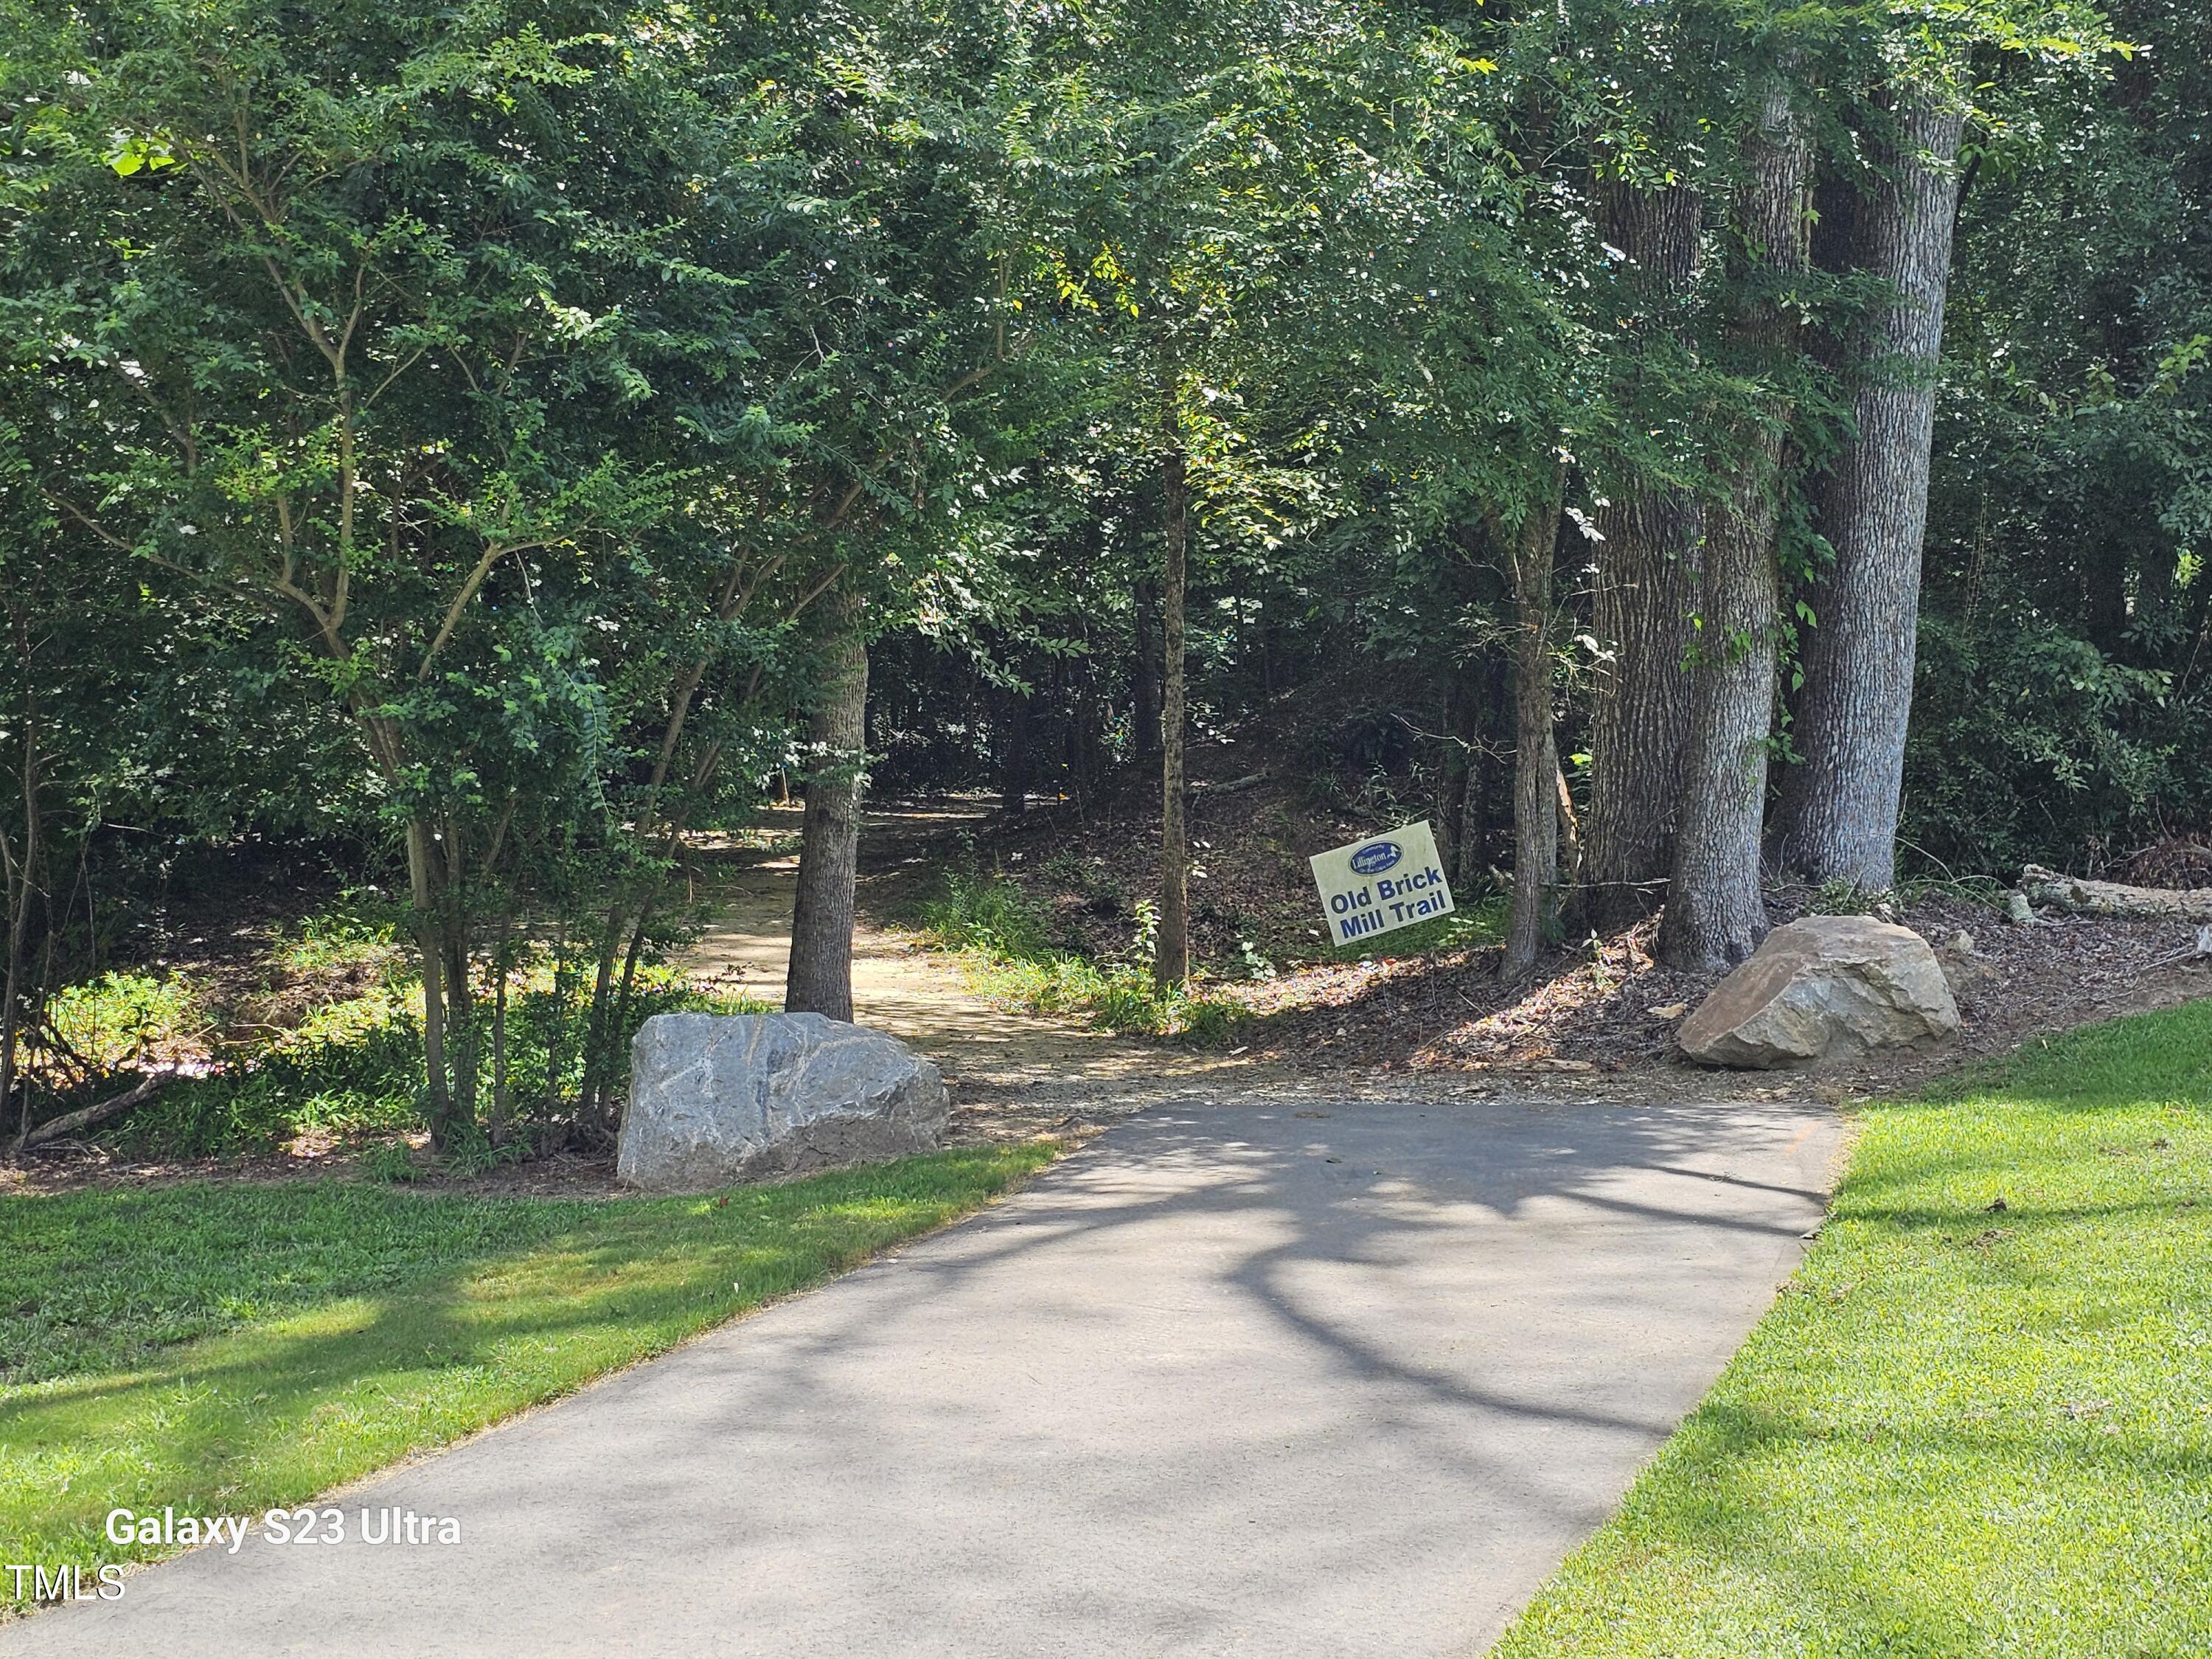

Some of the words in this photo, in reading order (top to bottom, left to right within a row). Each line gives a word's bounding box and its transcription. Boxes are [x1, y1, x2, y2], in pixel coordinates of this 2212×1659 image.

[1352, 852, 1386, 870] Lillington
[1331, 886, 1371, 914] Old
[1377, 866, 1442, 900] Brick
[1340, 909, 1385, 939] Mill
[1389, 890, 1446, 922] Trail
